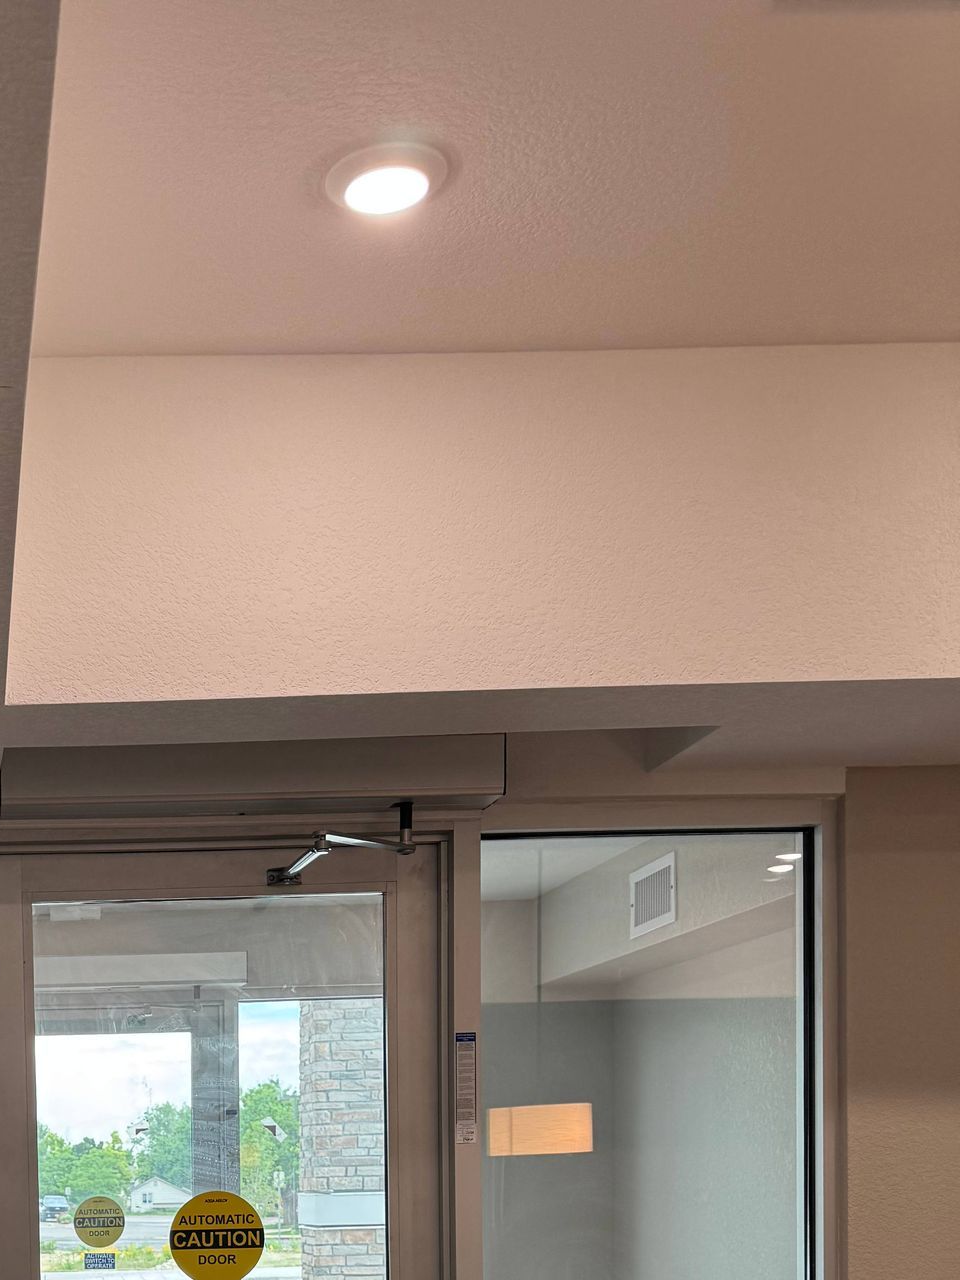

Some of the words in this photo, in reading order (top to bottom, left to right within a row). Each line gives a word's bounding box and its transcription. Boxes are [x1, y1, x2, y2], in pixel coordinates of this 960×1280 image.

[79, 1208, 120, 1216] AUTOMATIC
[75, 1218, 123, 1227] CAUTION
[178, 1214, 255, 1226] AUTOMATIC
[173, 1230, 260, 1248] CAUTION
[198, 1254, 236, 1265] DOOR
